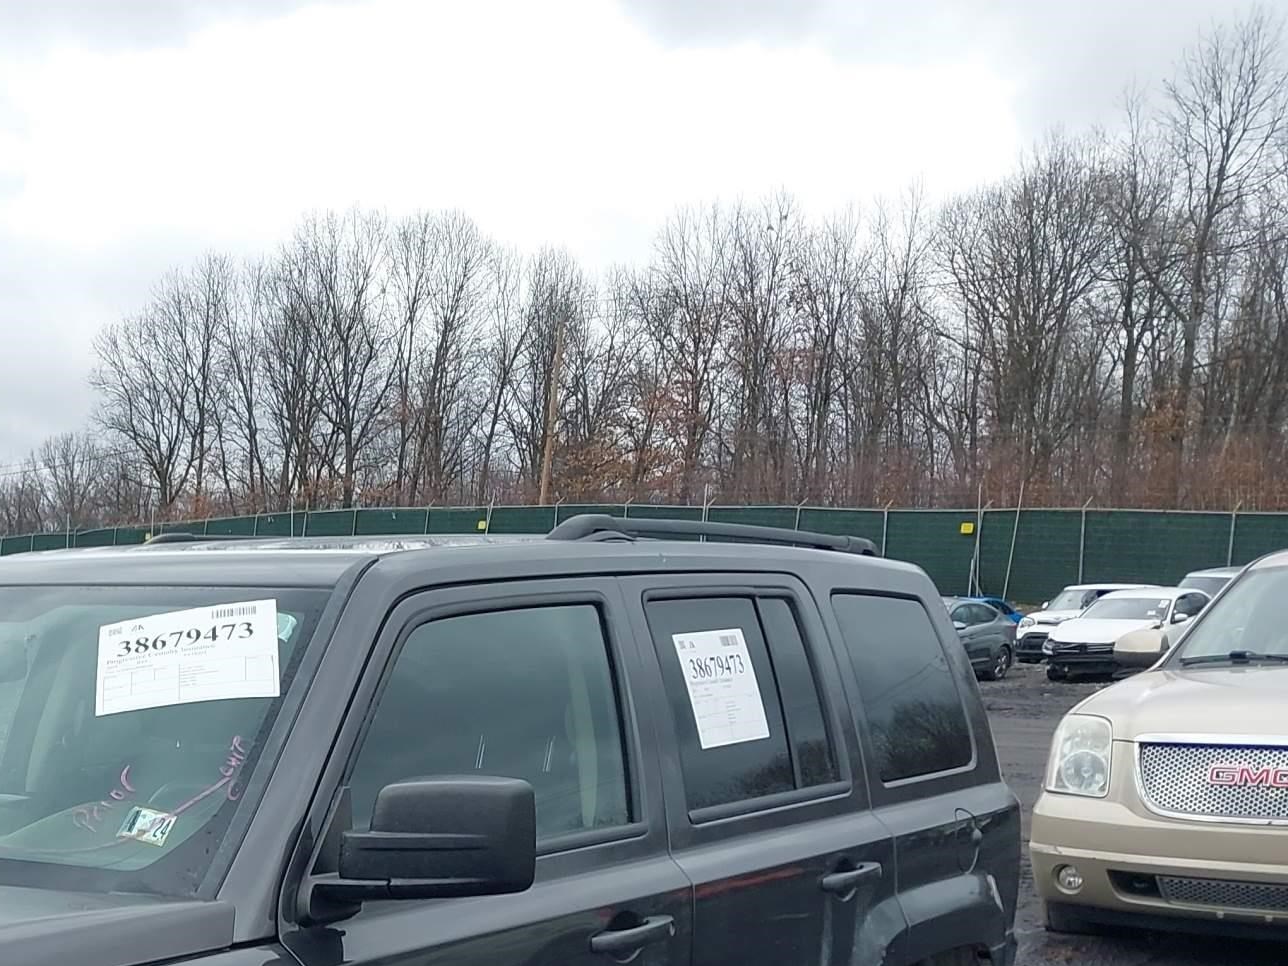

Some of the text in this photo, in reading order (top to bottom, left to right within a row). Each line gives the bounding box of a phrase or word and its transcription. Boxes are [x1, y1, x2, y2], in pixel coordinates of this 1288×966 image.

[117, 621, 254, 658] 38679473
[689, 653, 745, 680] 38679473
[1209, 767, 1288, 788] GMC
[152, 817, 172, 840] 24
